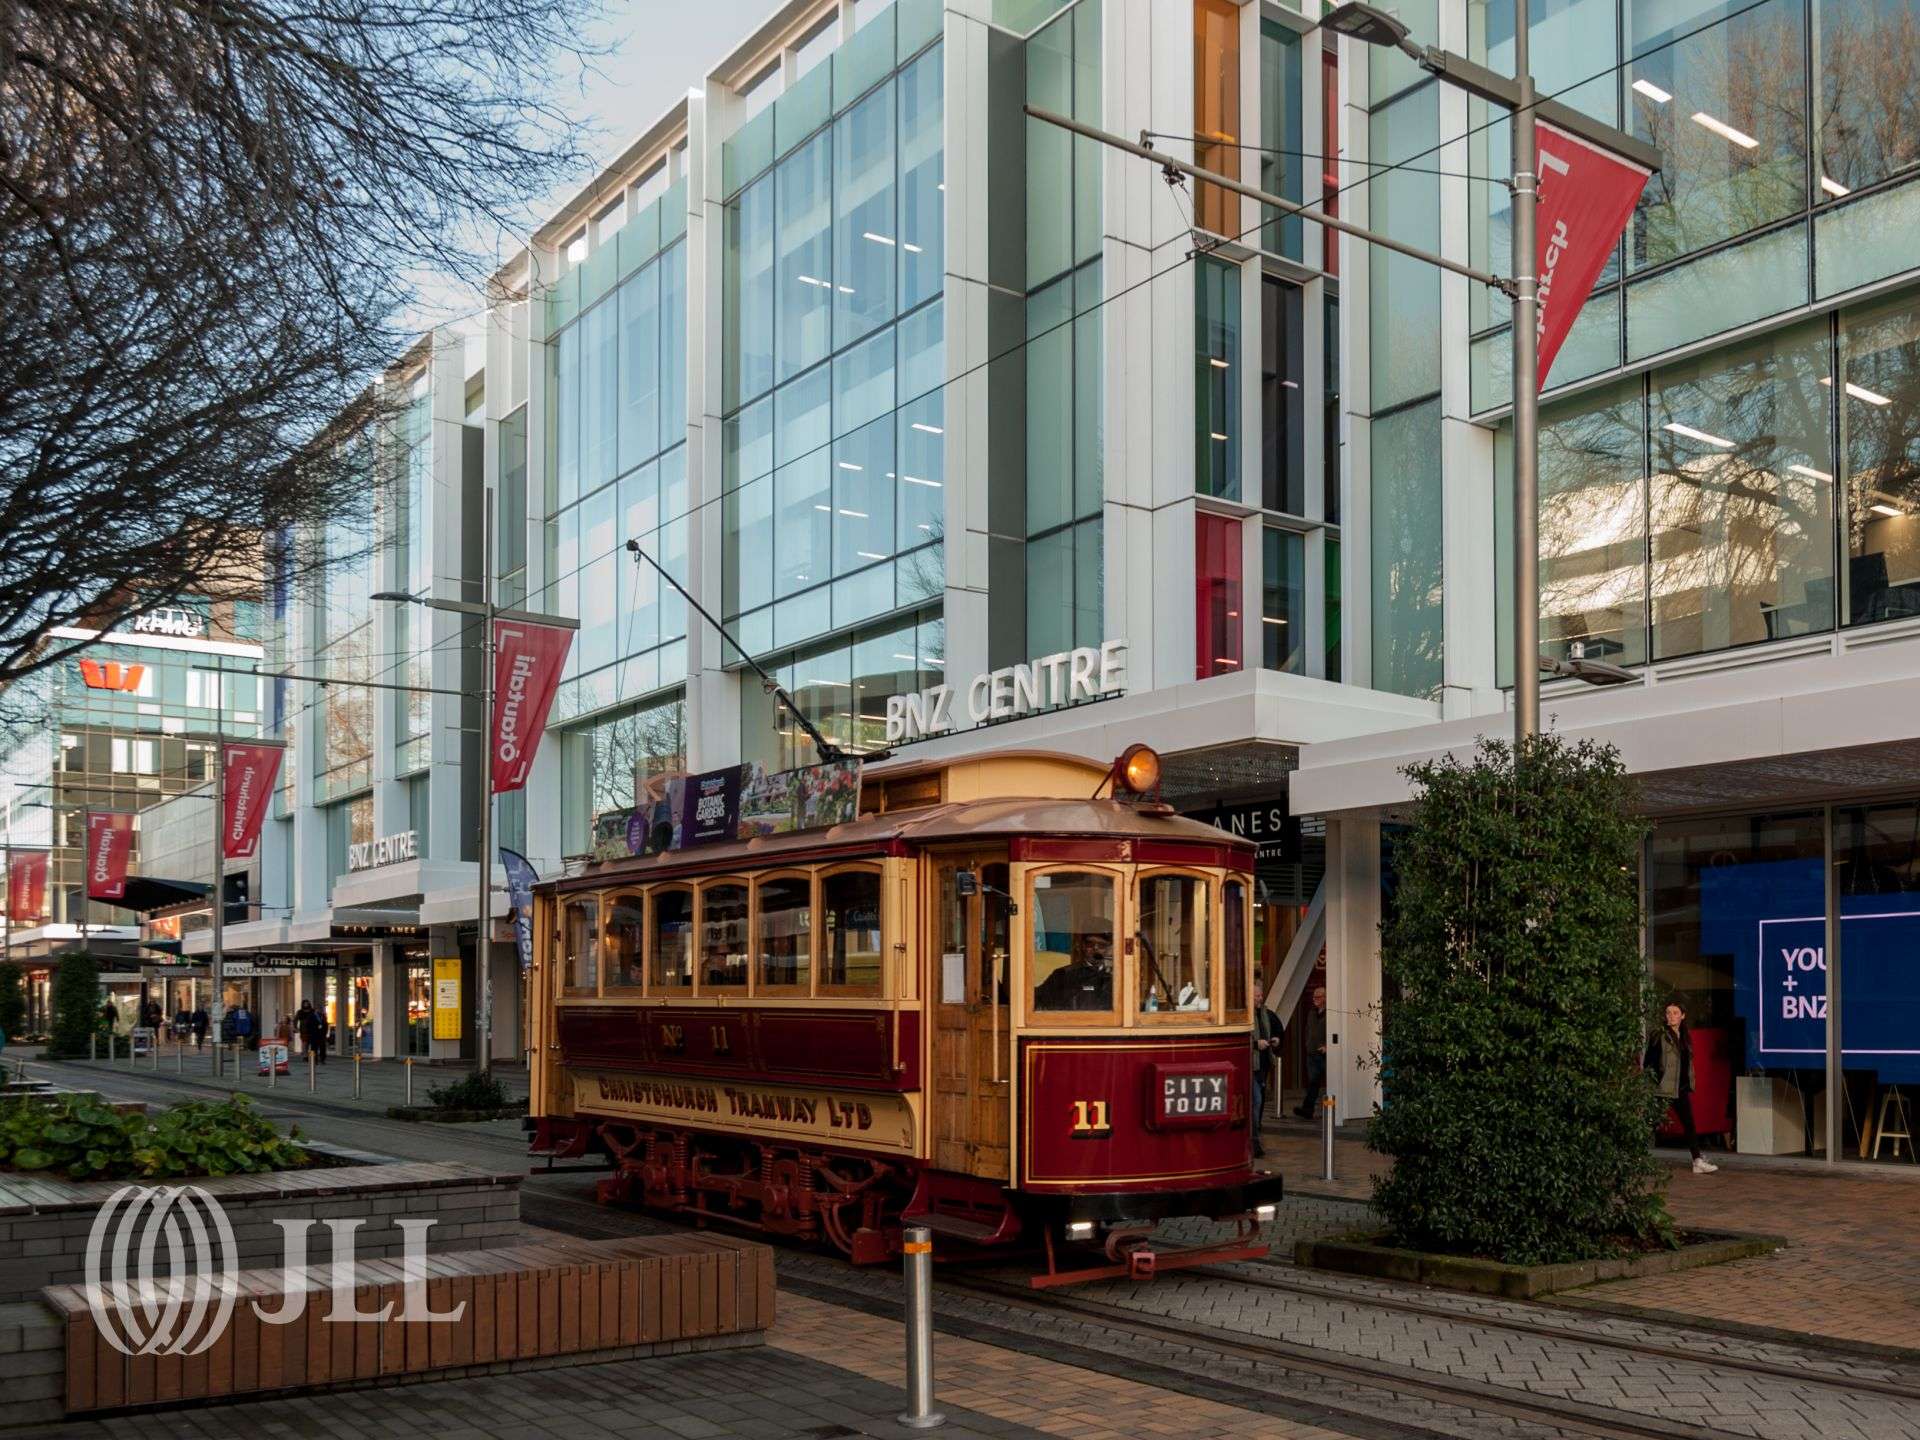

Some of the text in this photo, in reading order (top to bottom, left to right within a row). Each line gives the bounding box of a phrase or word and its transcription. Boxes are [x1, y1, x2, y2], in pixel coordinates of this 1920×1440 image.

[886, 638, 1129, 742] BNZ CENTRE
[1213, 808, 1282, 836] ANES
[349, 830, 418, 870] BNZ CENTRE
[1254, 848, 1282, 859] ENTRE
[270, 956, 337, 966] michael hill
[1781, 947, 1827, 972] YOU
[1782, 995, 1828, 1019] BNZ
[1164, 1077, 1223, 1095] CITY
[1072, 1100, 1111, 1132] 11
[1164, 1096, 1223, 1114] TOUR
